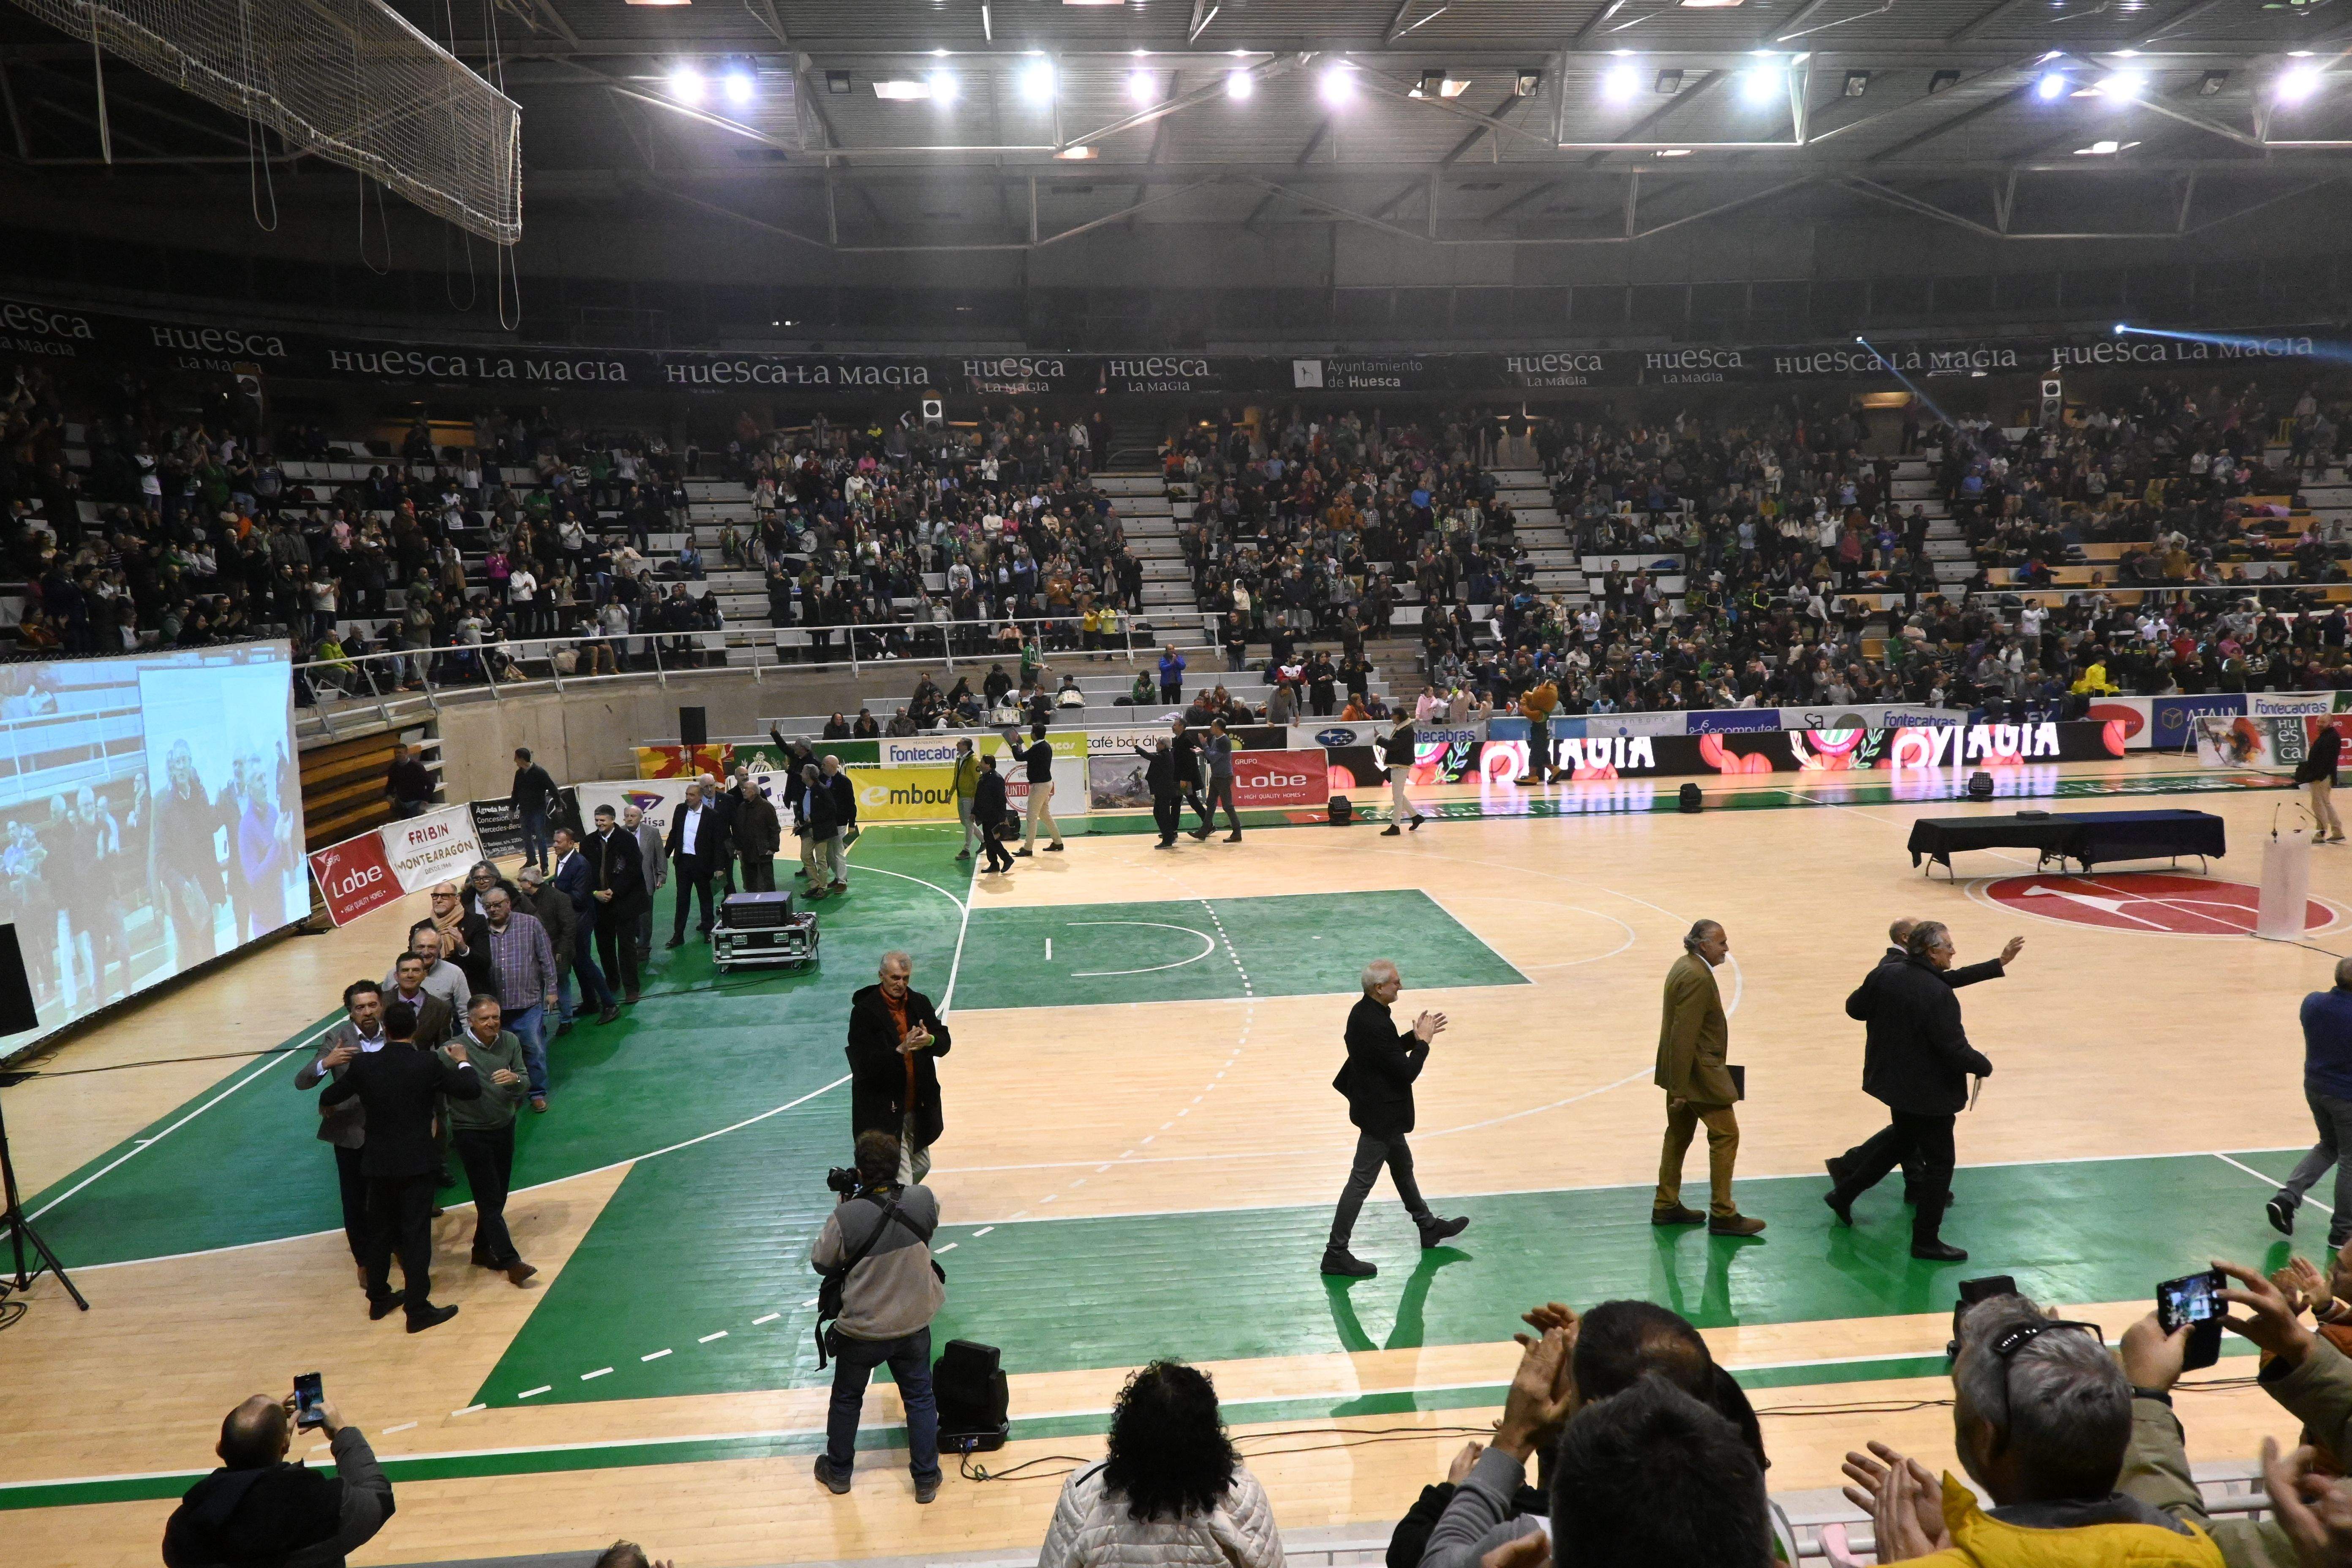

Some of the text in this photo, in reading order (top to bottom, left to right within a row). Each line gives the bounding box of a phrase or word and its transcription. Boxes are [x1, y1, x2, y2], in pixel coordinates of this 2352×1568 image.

[149, 326, 288, 357] Huesca
[1506, 353, 1604, 372] Huesca
[1646, 349, 1743, 369] Huesca
[1774, 351, 1883, 373] Huesca
[2051, 341, 2168, 365] Huesca
[327, 350, 469, 377] Huesca
[477, 357, 516, 378] La
[664, 361, 789, 384] Huesca
[798, 365, 831, 384] La
[962, 357, 1066, 377] Huesca
[1109, 356, 1210, 377] Huesca
[1327, 360, 1423, 375] Ayuntamiento
[1128, 381, 1143, 392] La
[1328, 376, 1401, 388] de Huesca
[1527, 377, 1542, 387] La
[2255, 699, 2328, 714] Fontecabras
[1086, 736, 1113, 748] café
[890, 745, 956, 762] Fontecabr
[1236, 771, 1307, 788] Lobe
[860, 783, 950, 807] embou
[408, 823, 449, 845] FRIBIN
[332, 866, 383, 899] Lobe
[344, 890, 384, 914] HIGH QUALITY HOMES
